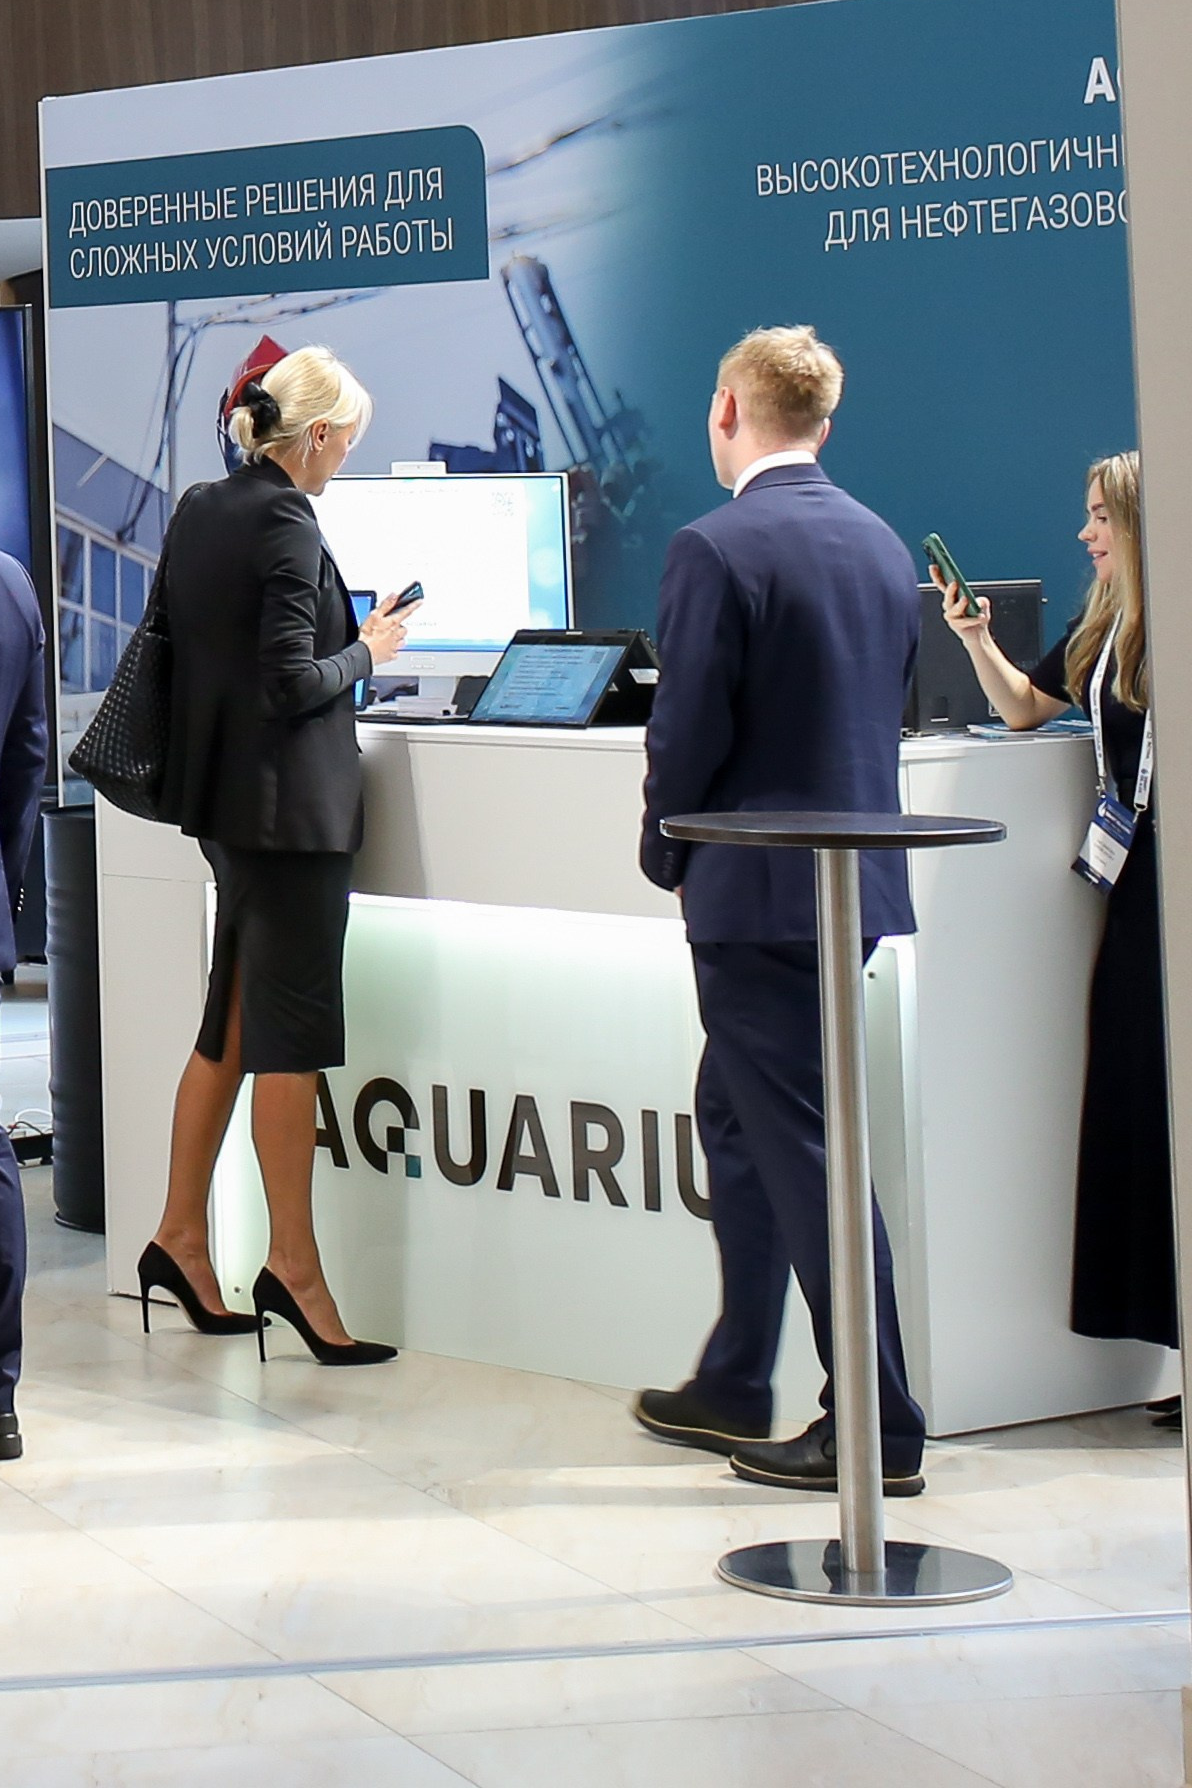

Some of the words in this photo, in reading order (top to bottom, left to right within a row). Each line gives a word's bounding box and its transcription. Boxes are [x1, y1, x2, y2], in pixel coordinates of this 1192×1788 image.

[1083, 56, 1121, 104] A
[756, 133, 1126, 196] ВЫСОКОТЕХНОЛОГИЧН
[69, 186, 238, 238] ДОВЕРЕННЫЕ
[246, 173, 375, 216] РЕШЕНИЯ
[384, 166, 443, 212] ДЛЯ
[824, 207, 891, 251] ДЛЯ
[69, 238, 198, 279] СЛОЖНЫХ
[207, 221, 333, 269] УСЛОВИЙ
[342, 217, 454, 258] РАБОТЫ
